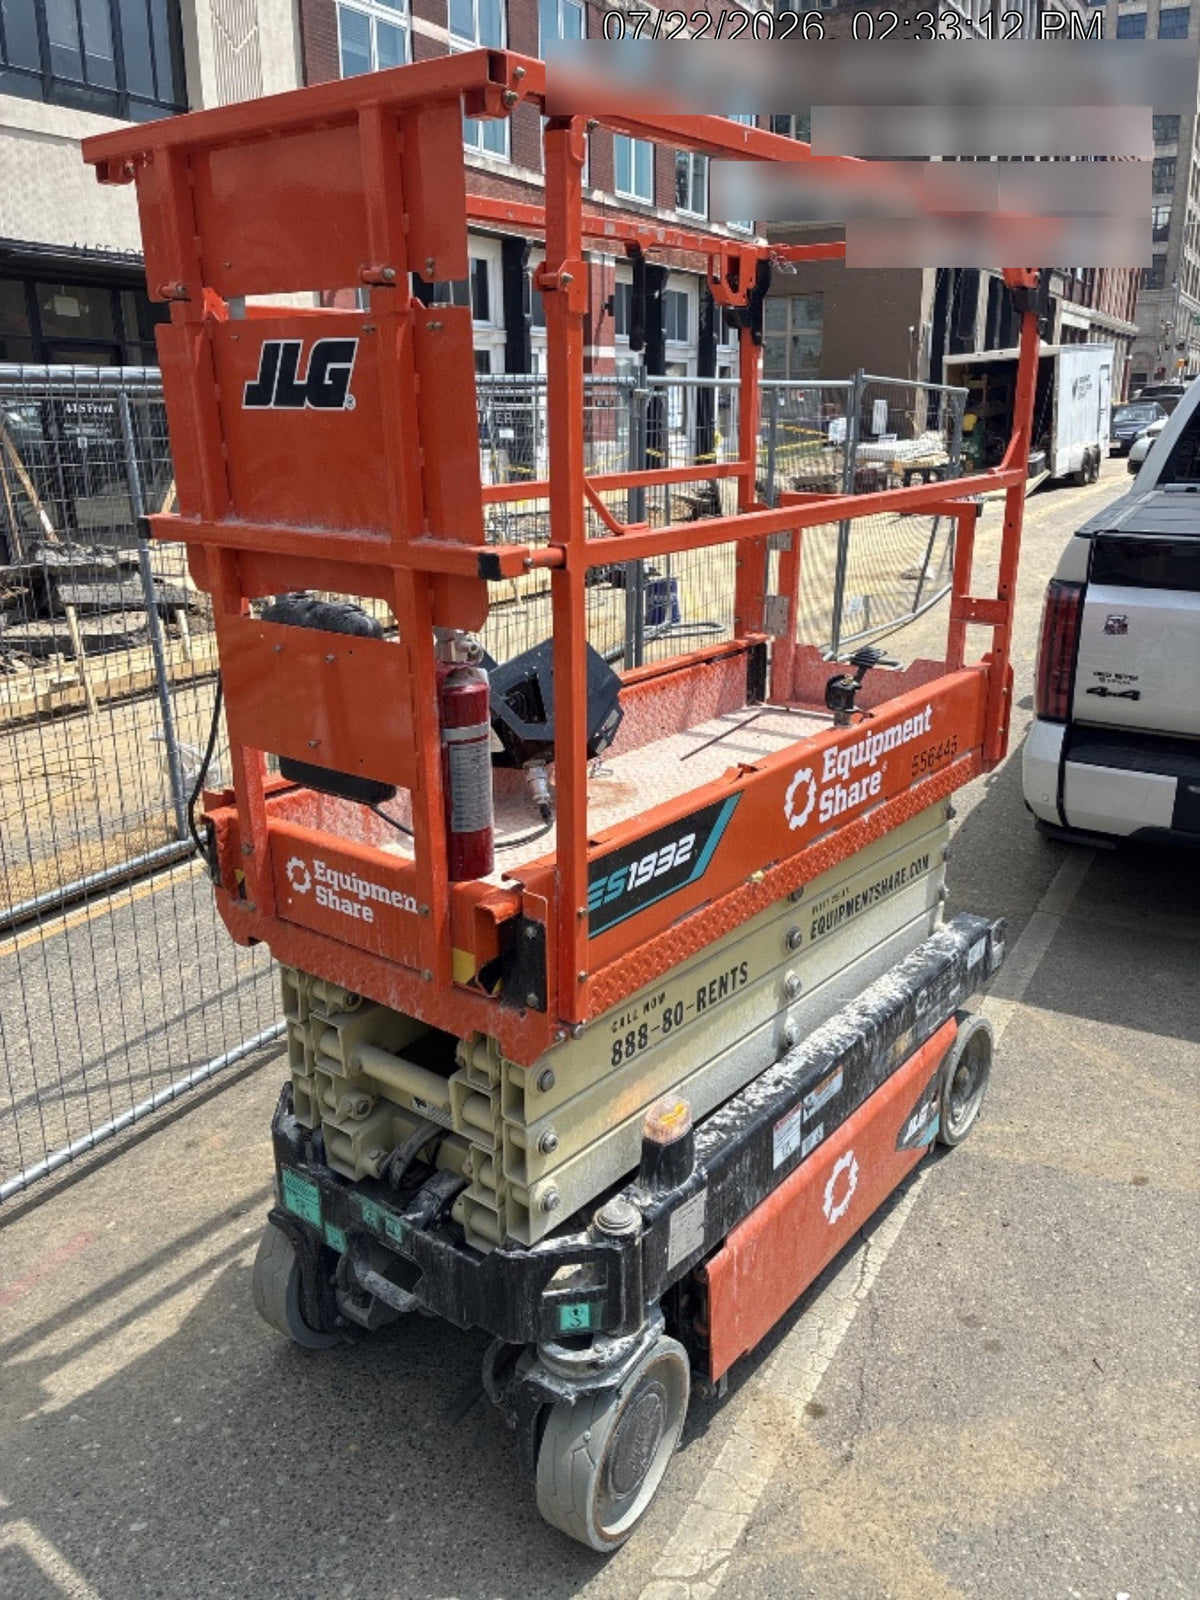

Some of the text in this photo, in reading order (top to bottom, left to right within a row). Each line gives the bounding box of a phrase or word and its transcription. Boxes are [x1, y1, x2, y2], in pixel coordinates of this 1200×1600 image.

[242, 337, 359, 410] JLG
[821, 703, 933, 783] Equipment
[818, 770, 882, 823] Share
[313, 859, 418, 914] Equipmen
[315, 885, 374, 923] Share
[588, 833, 696, 911] ES1932
[810, 854, 930, 940] EQUIPMENTSHARE.COM
[610, 961, 748, 1067] 888-80-RENTS
[611, 992, 666, 1033] CALL NOW
